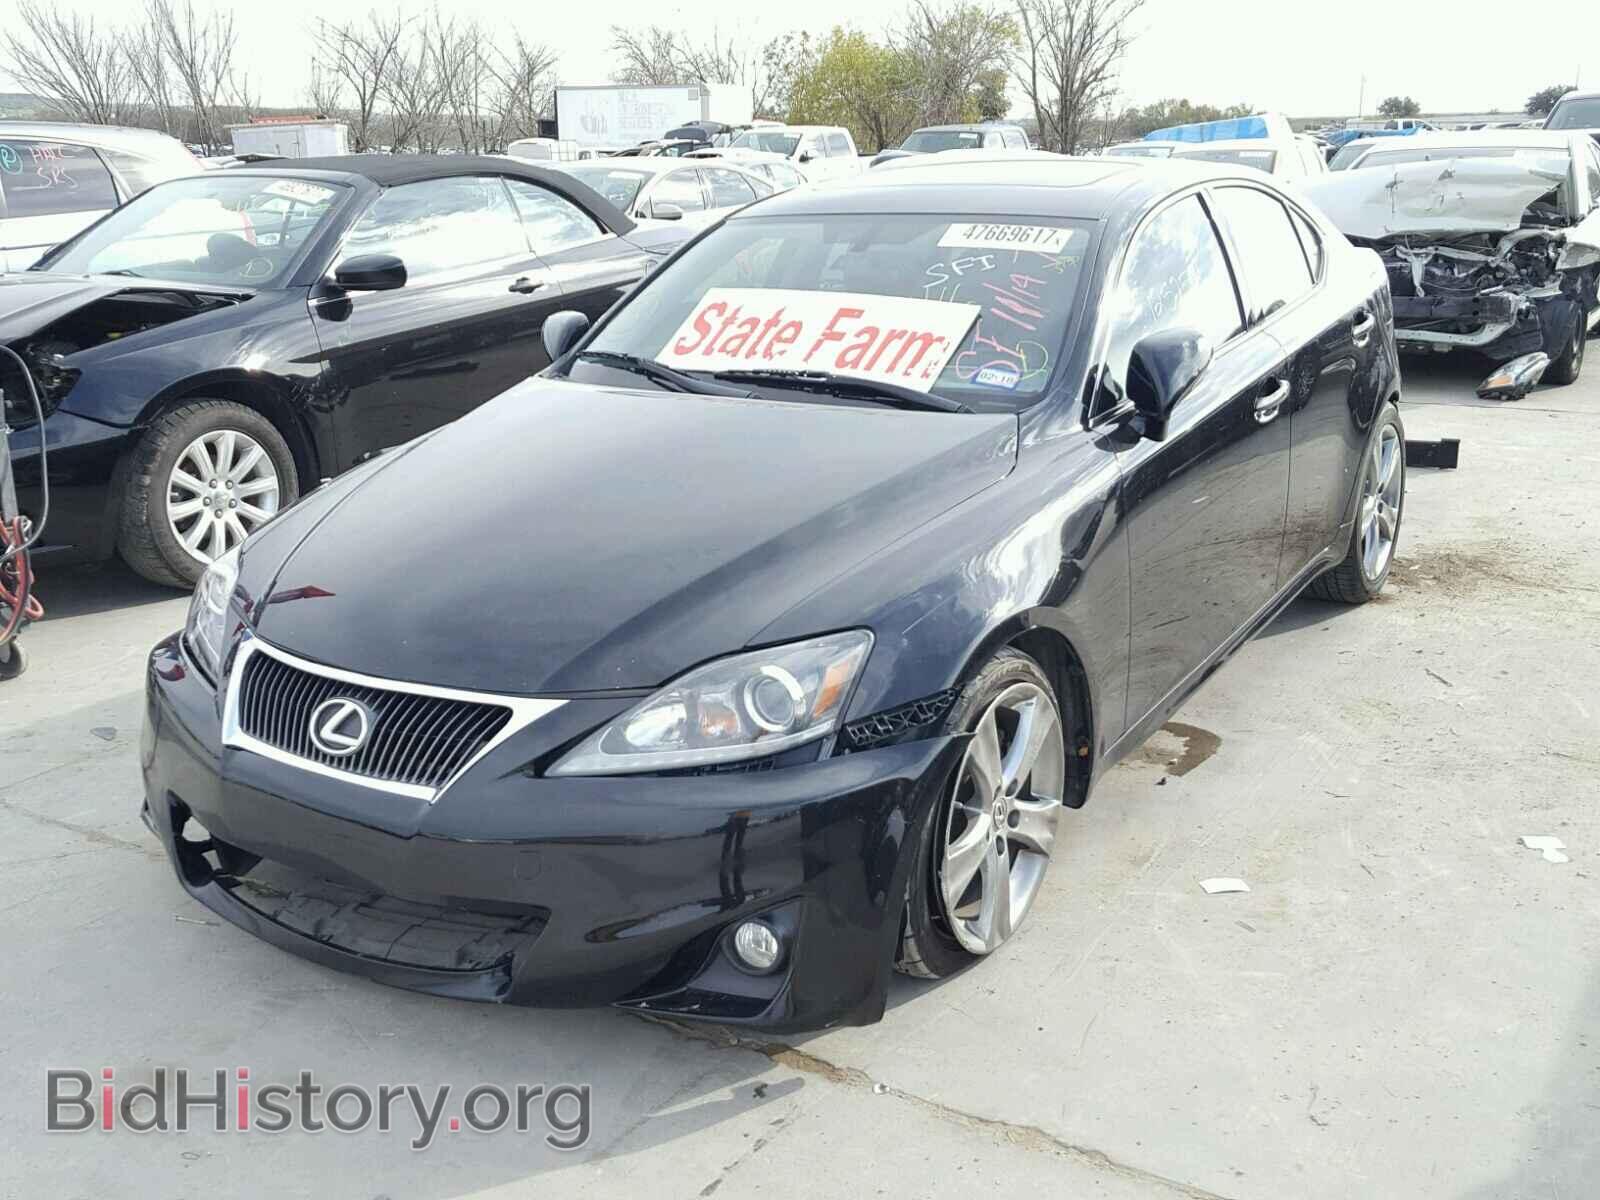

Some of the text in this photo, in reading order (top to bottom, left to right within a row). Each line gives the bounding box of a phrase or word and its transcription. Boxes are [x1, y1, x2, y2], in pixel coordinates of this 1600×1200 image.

[962, 223, 1056, 244] 47669617
[672, 300, 803, 360] State
[803, 306, 950, 379] Farm
